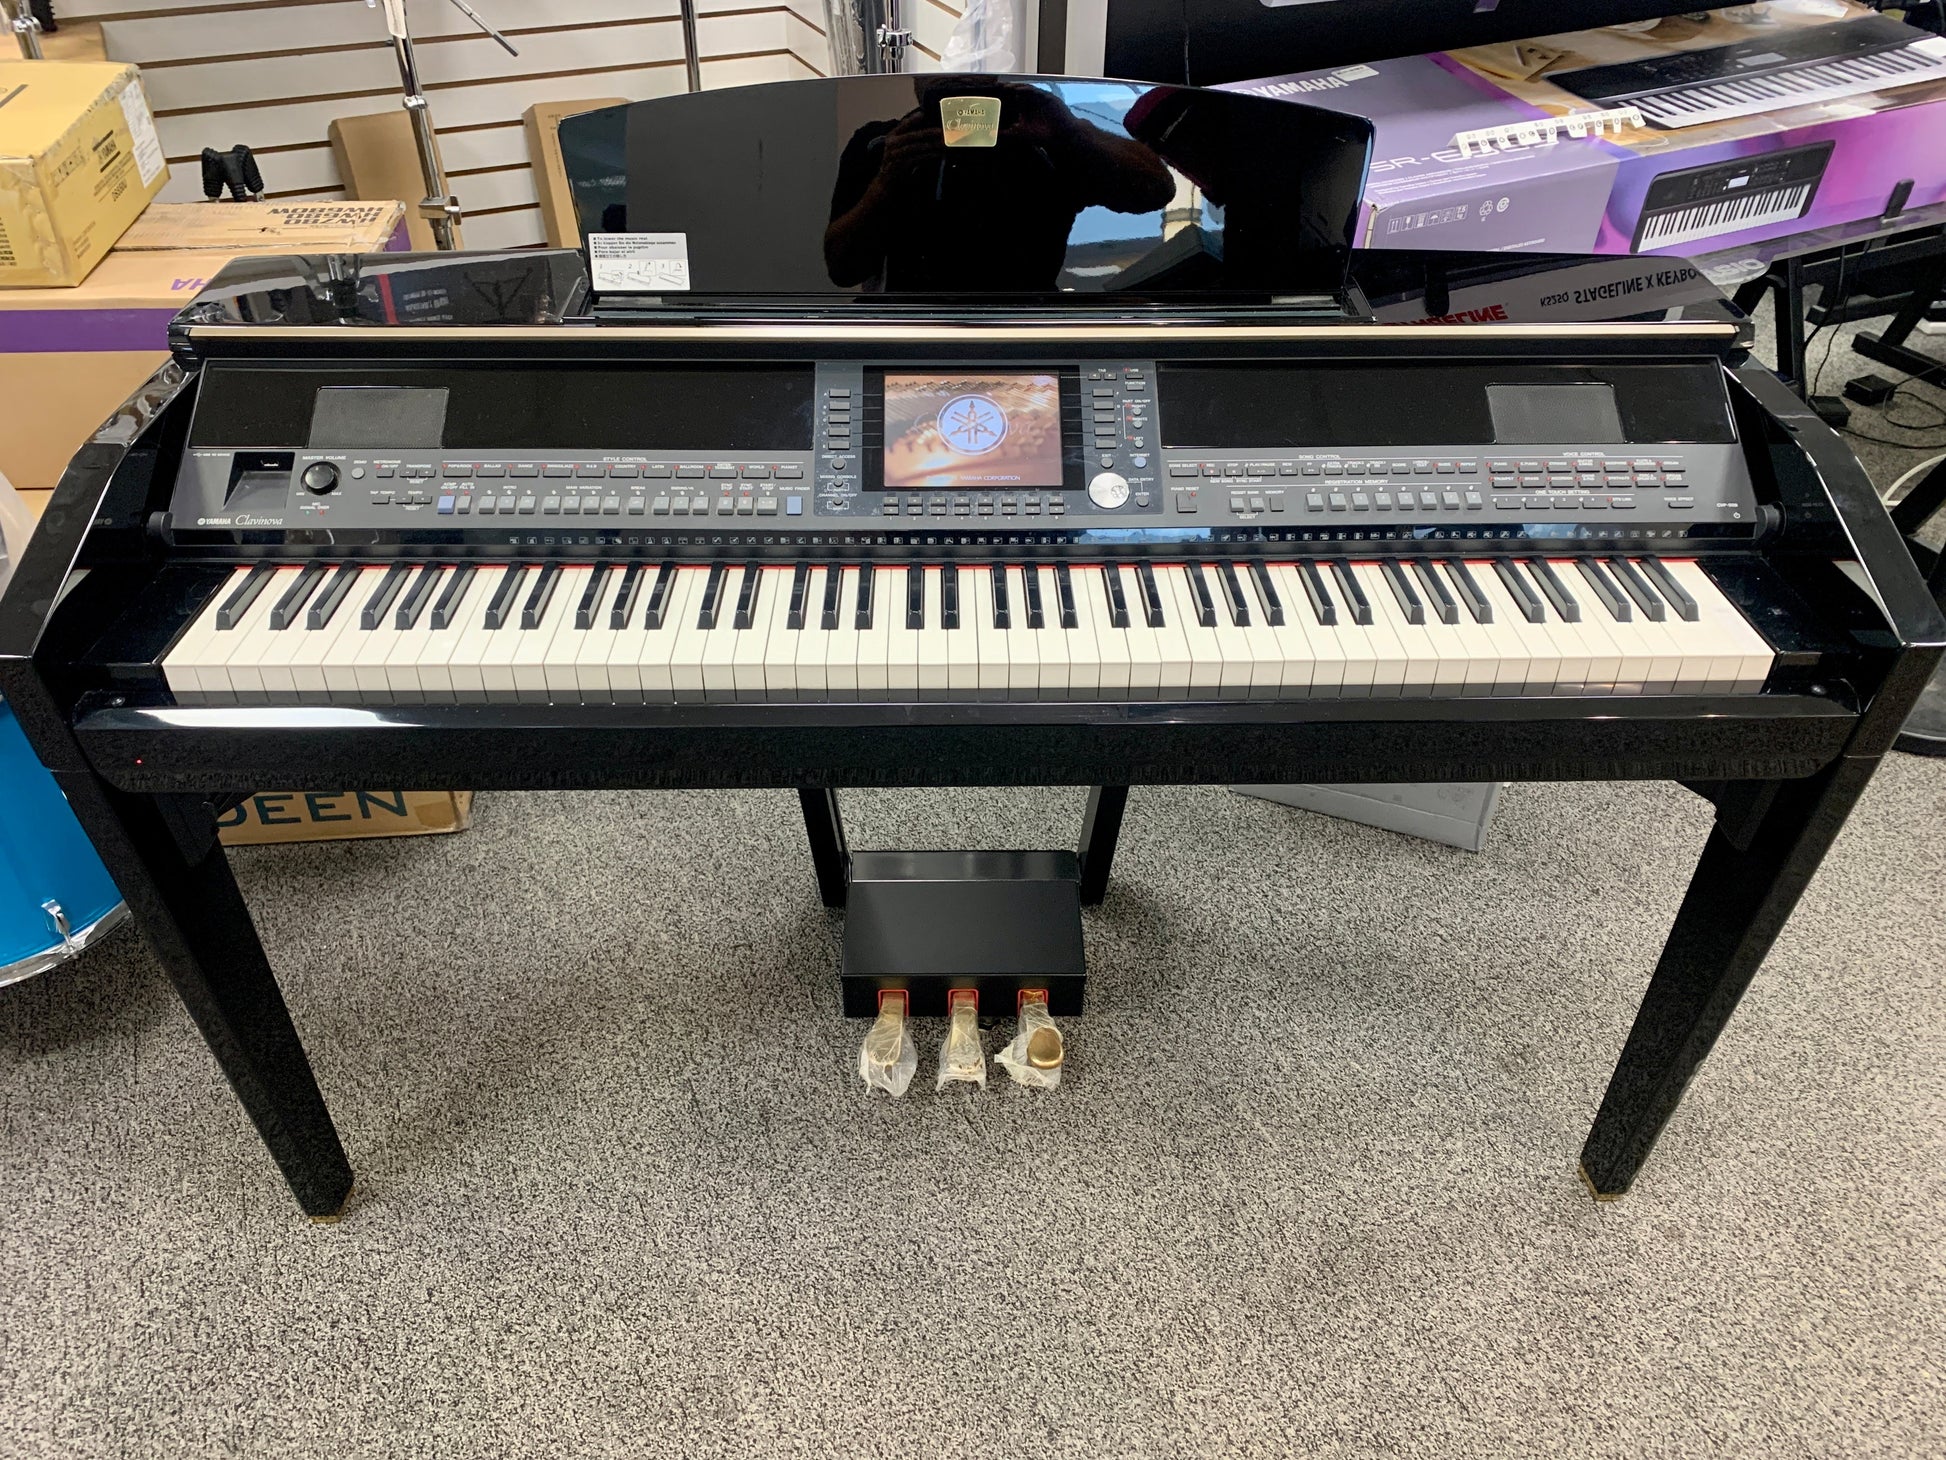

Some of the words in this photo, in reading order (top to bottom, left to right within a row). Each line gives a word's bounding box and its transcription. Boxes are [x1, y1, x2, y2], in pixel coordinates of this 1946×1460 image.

[1257, 76, 1349, 98] YAMAHA
[267, 207, 384, 215] HW680W
[235, 514, 284, 526] Clavinova
